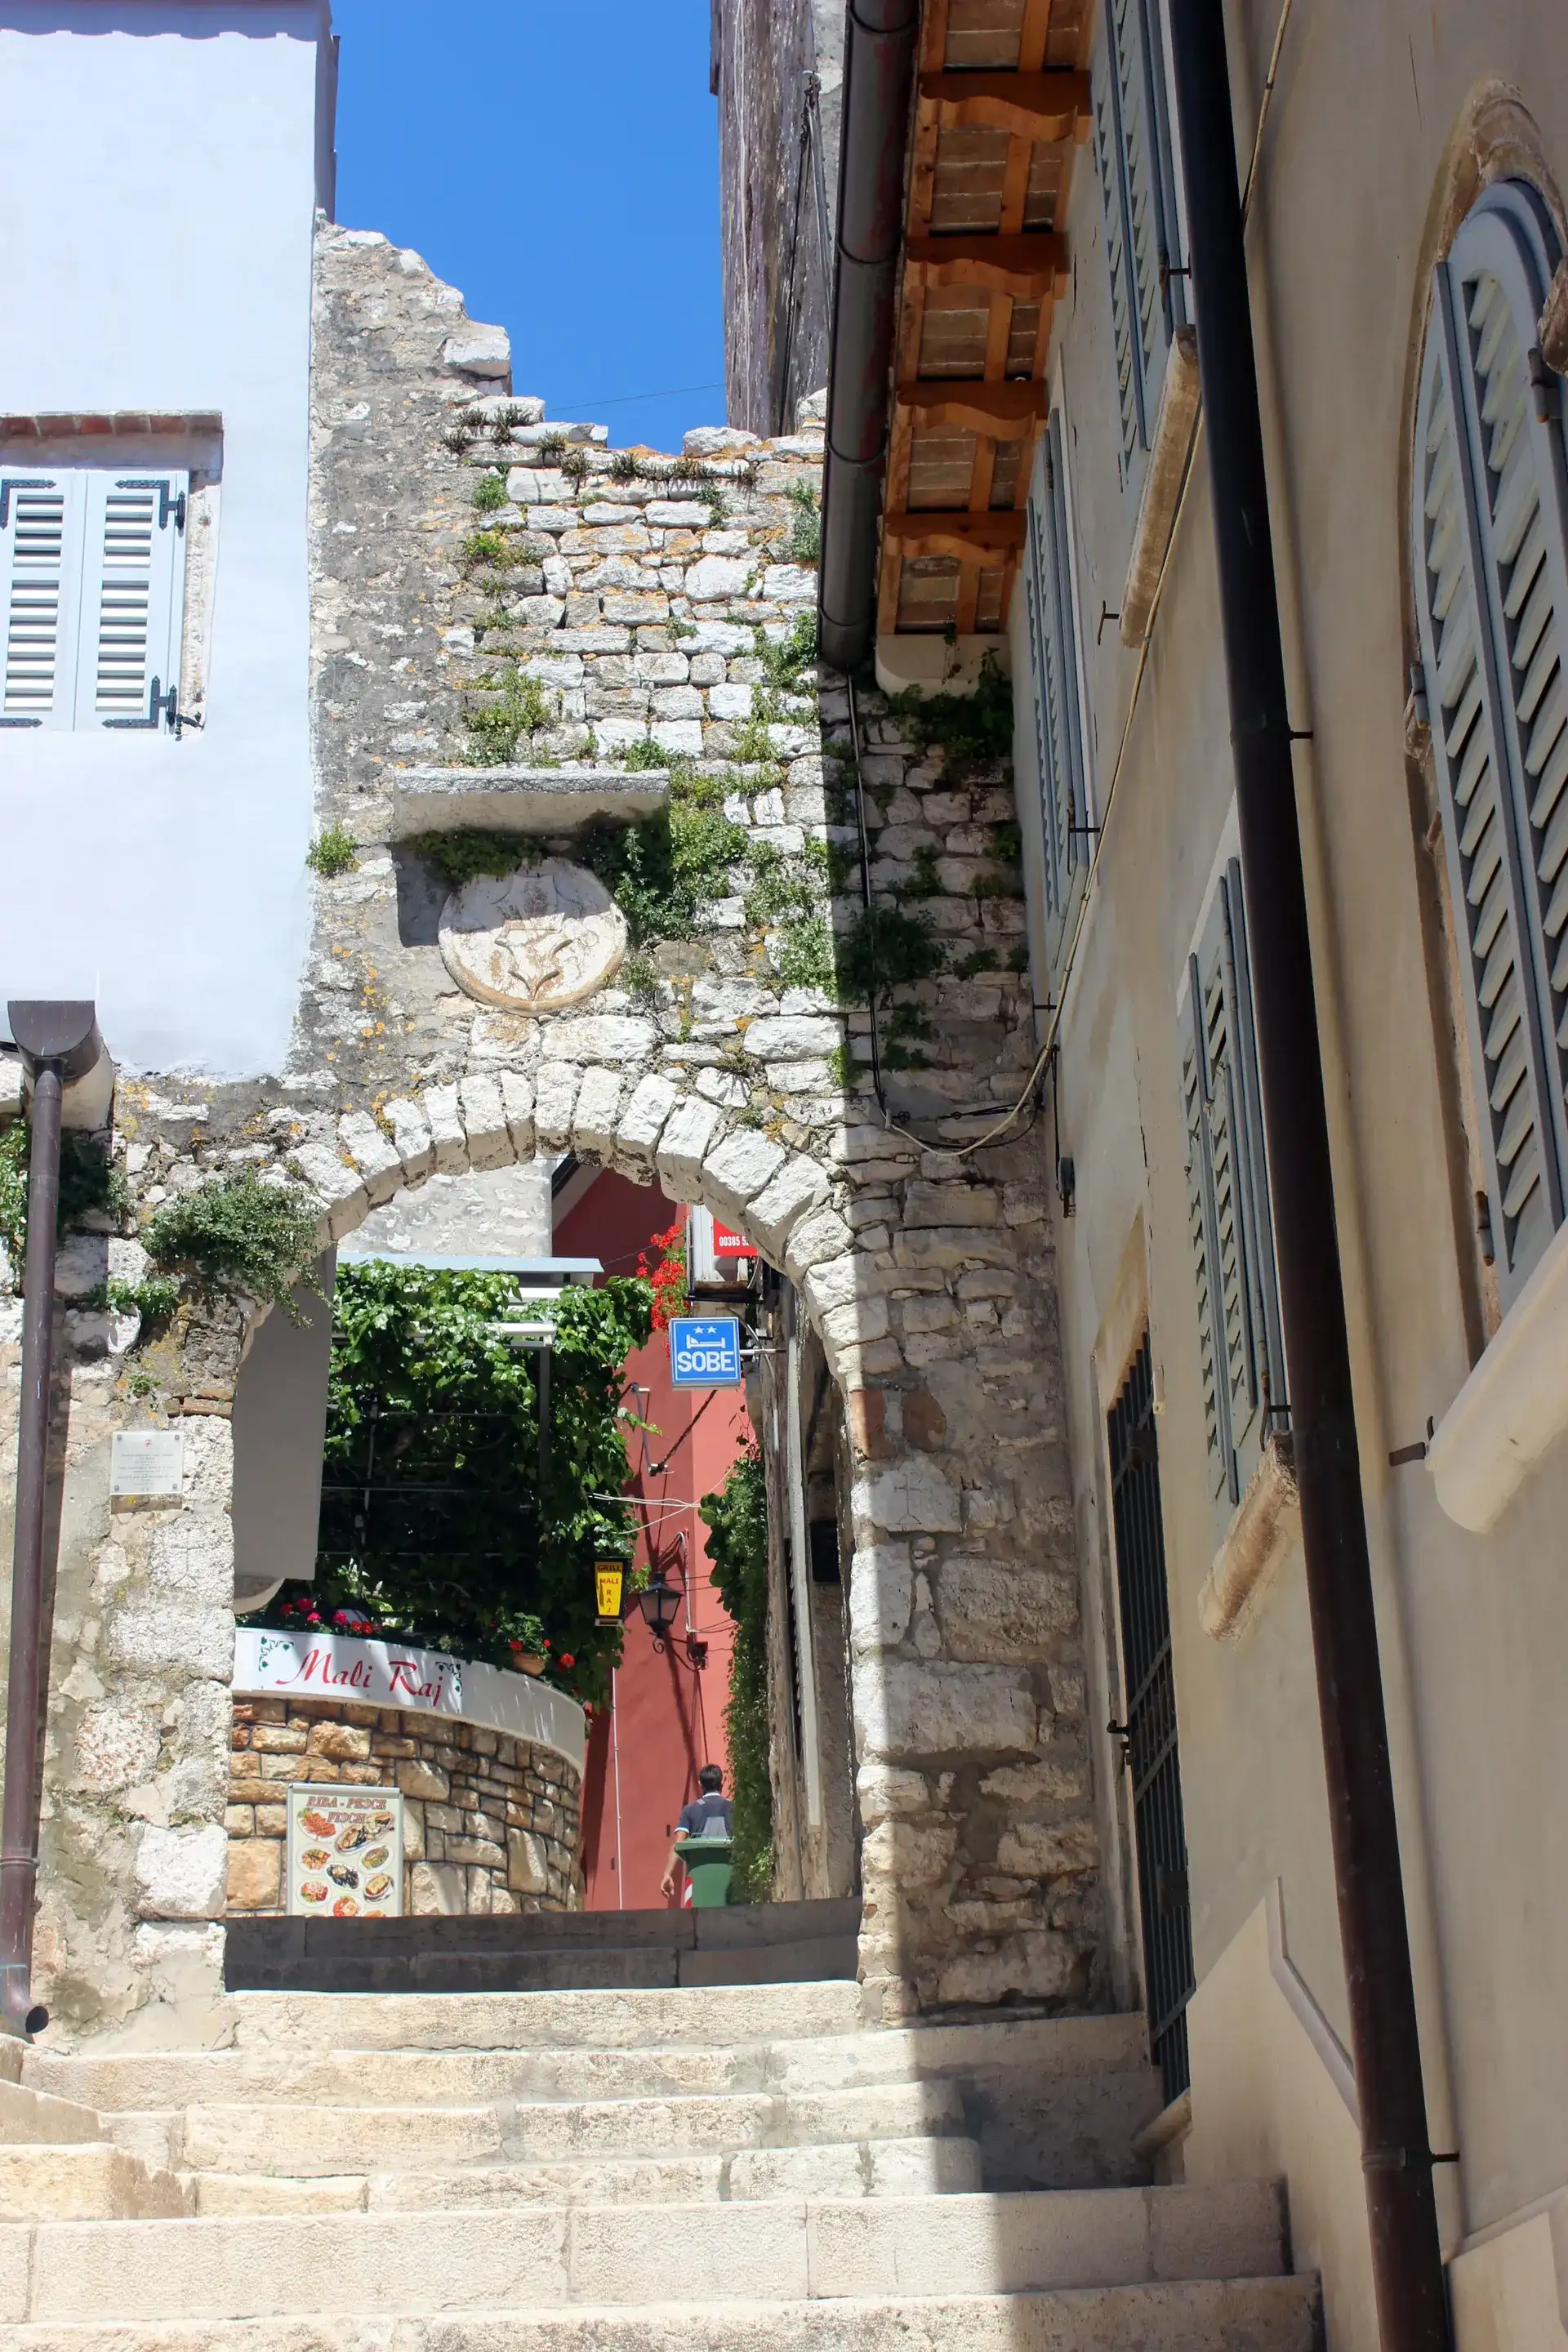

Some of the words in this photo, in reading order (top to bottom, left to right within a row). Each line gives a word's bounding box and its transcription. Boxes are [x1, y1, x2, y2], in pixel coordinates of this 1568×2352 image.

[719, 1236, 740, 1247] 00385
[677, 1351, 735, 1373] SOBE
[276, 1648, 372, 1688] Mali
[389, 1660, 443, 1707] Raj
[306, 1796, 337, 1807] RIBA
